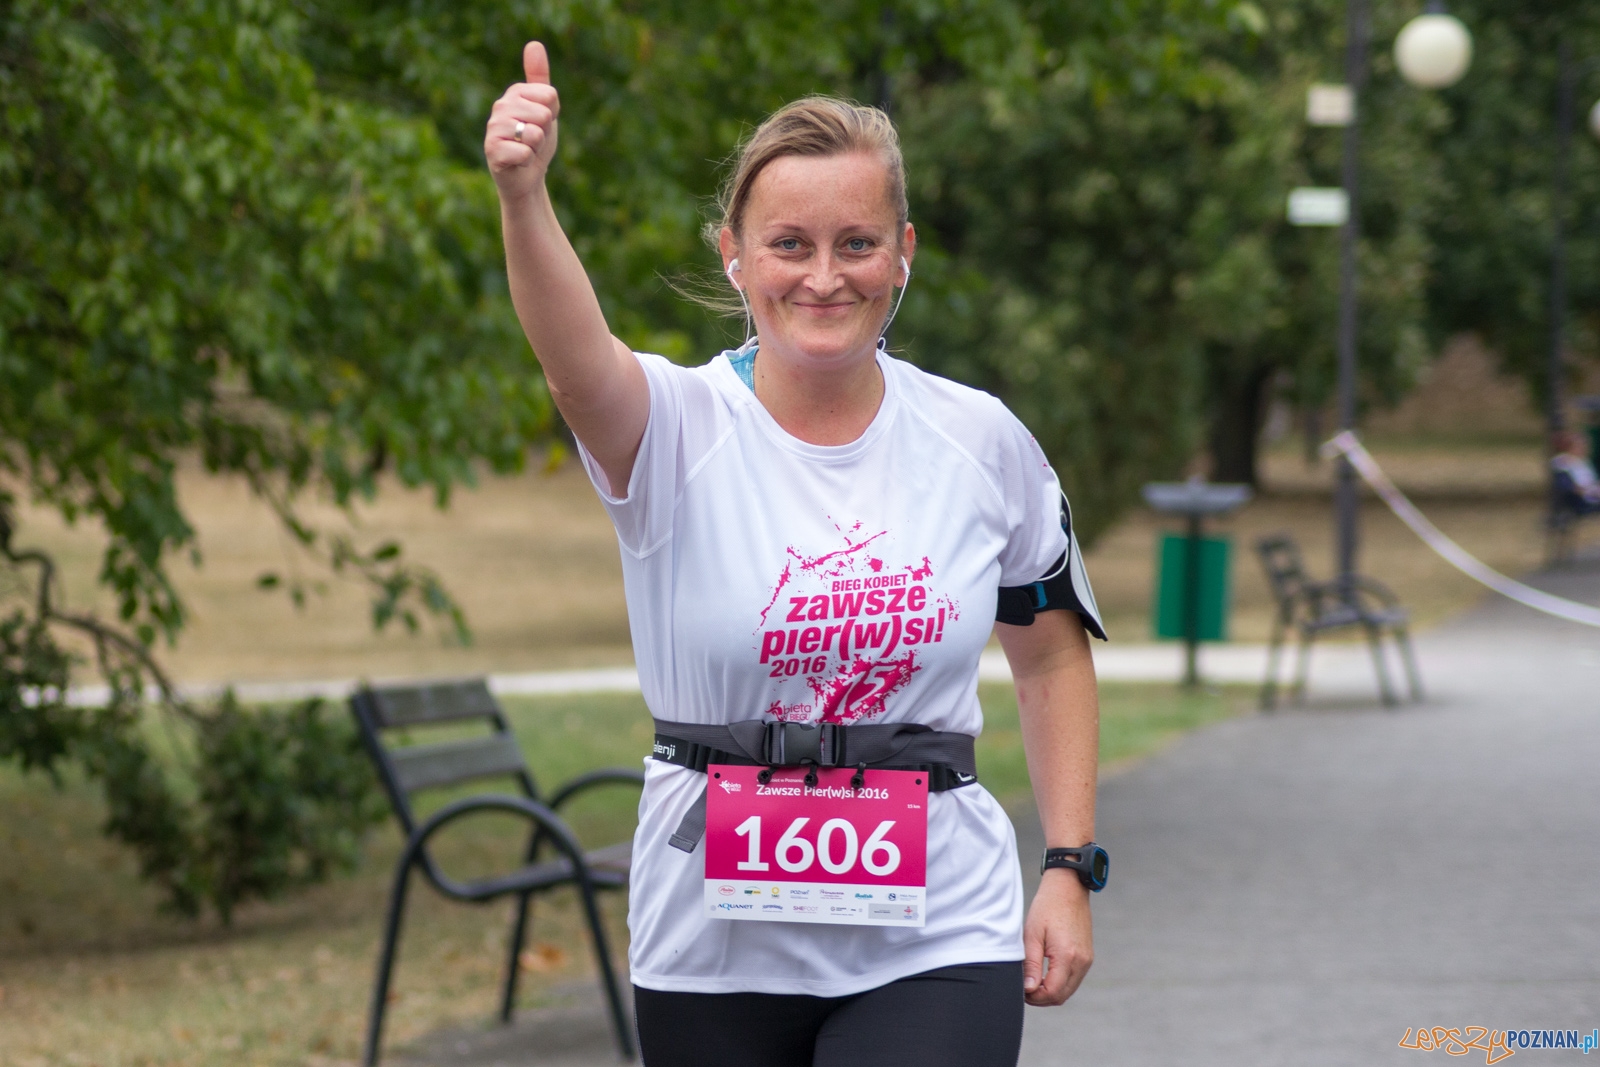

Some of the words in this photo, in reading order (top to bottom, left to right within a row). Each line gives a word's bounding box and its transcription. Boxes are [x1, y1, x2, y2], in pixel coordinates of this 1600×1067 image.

[832, 579, 861, 592] BIEG
[863, 574, 908, 589] KOBIET
[786, 585, 926, 623] zawsze
[759, 608, 945, 664] pier(w)si!
[769, 656, 827, 677] 2016
[756, 784, 801, 796] Zawsze
[804, 785, 855, 799] Pier(w)si
[857, 787, 889, 799] 2016
[734, 815, 901, 876] 1606
